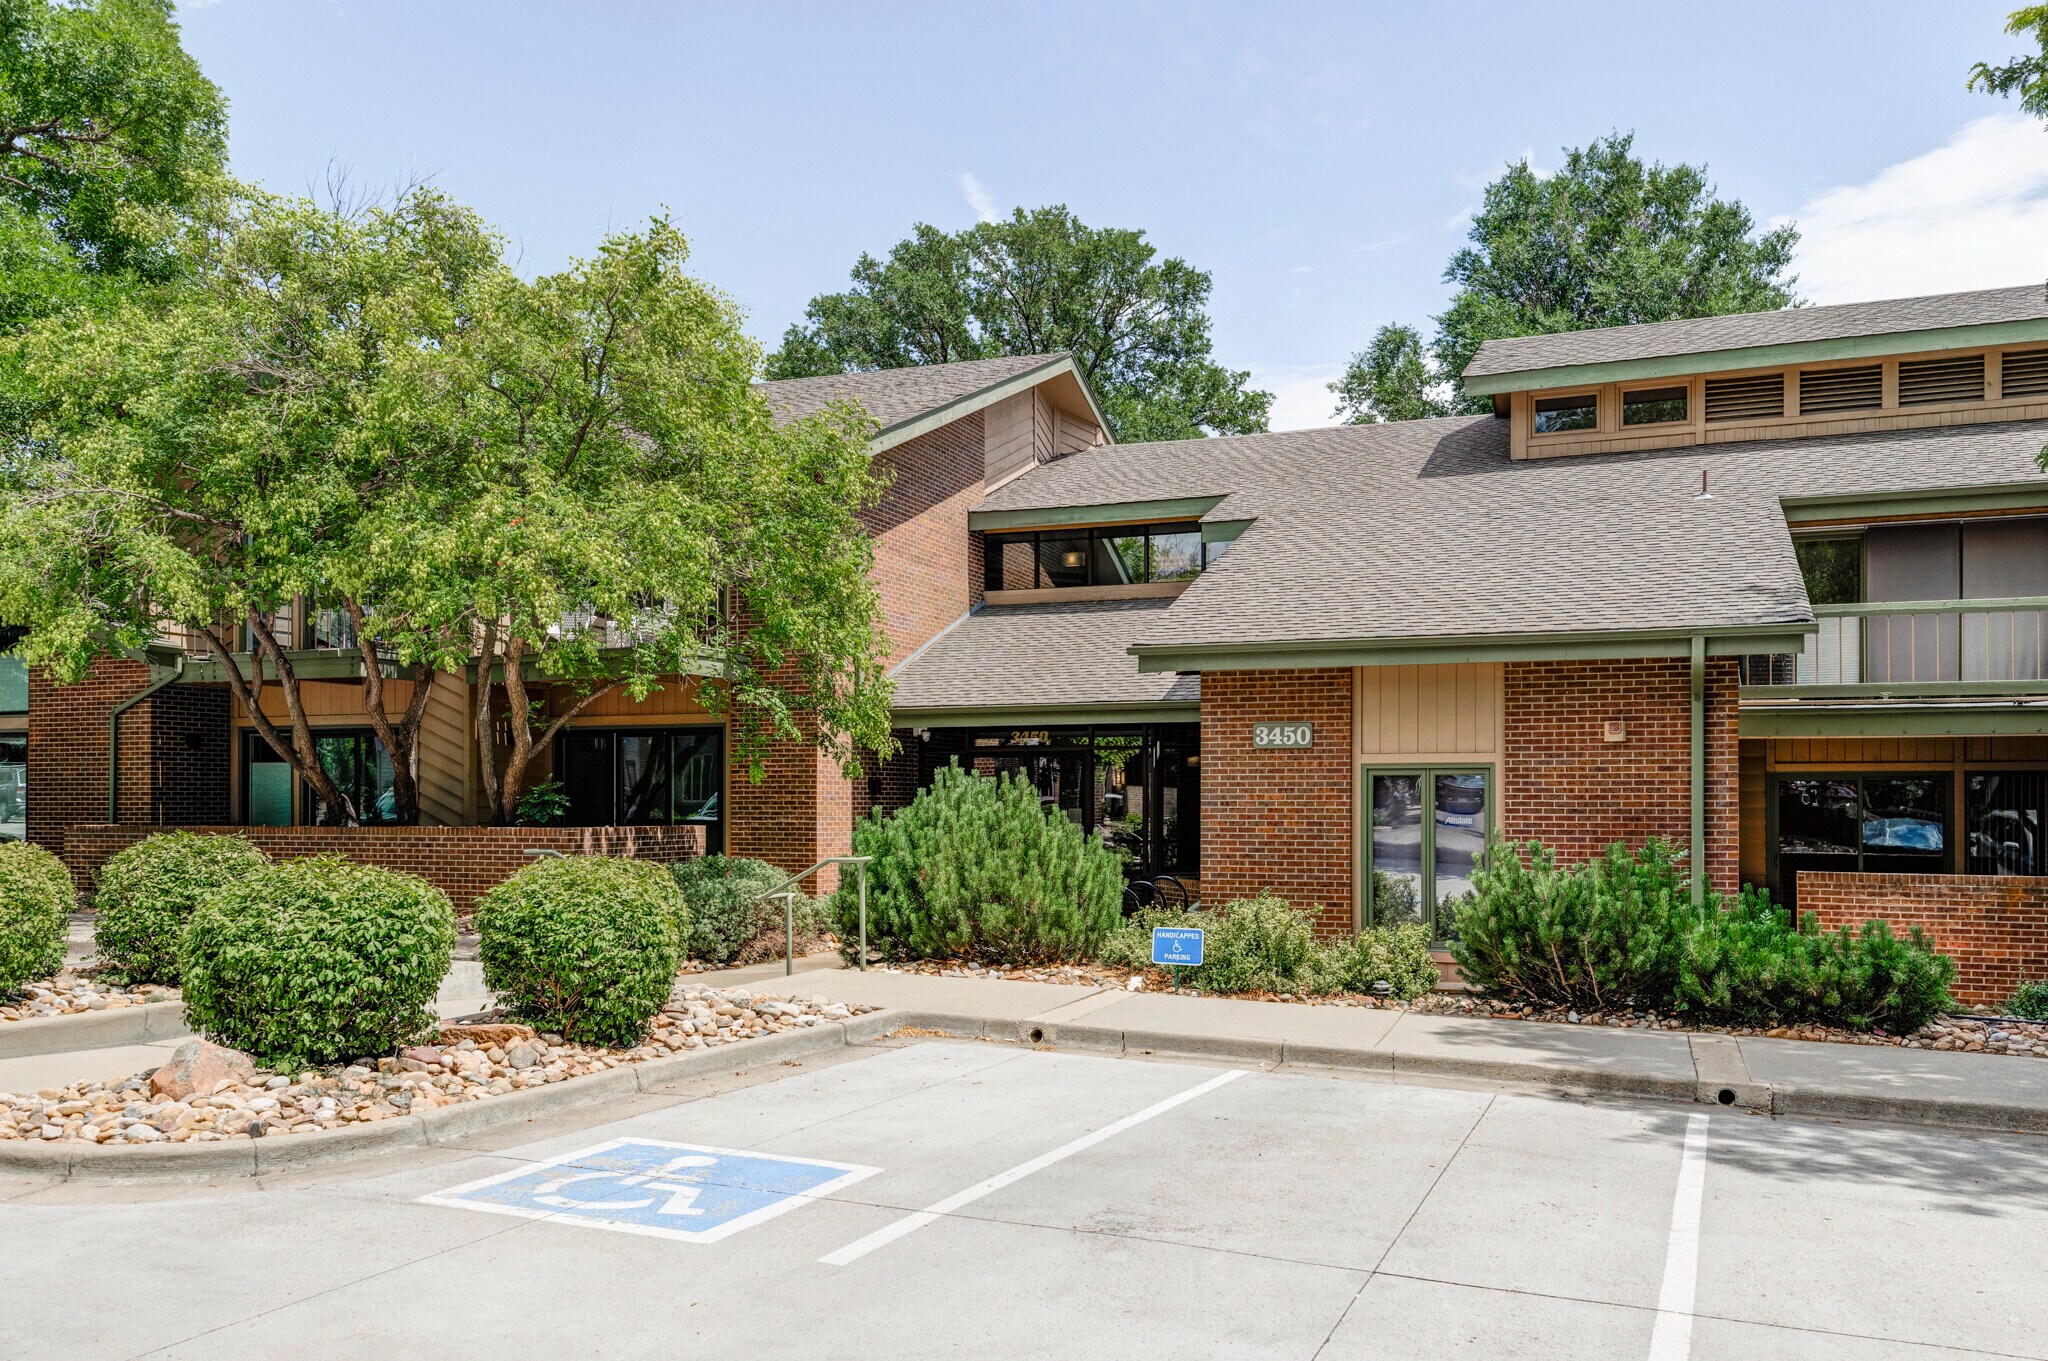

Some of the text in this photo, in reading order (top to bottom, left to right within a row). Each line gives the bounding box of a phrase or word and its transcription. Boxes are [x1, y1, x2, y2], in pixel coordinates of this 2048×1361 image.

[1010, 730, 1049, 743] 3450
[1255, 726, 1311, 745] 3450
[1444, 816, 1473, 825] Allstate
[1156, 931, 1200, 940] HANDICAPPED
[1164, 953, 1191, 961] PARKING
